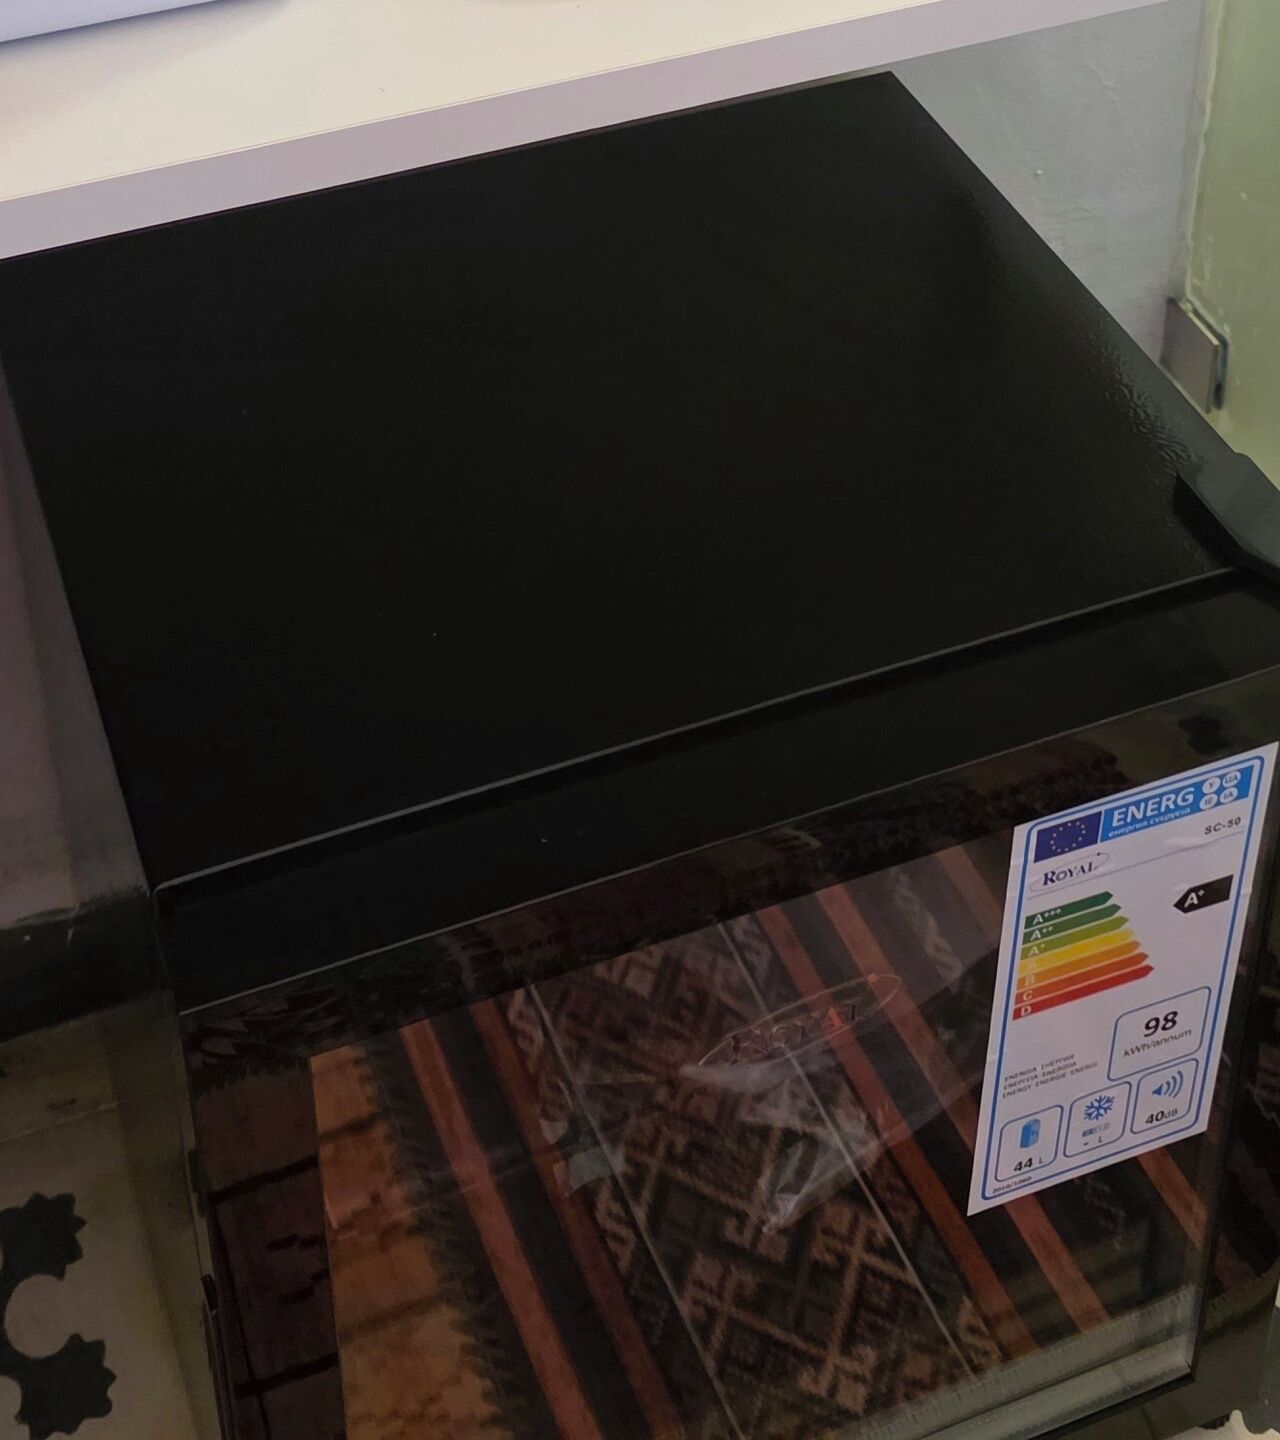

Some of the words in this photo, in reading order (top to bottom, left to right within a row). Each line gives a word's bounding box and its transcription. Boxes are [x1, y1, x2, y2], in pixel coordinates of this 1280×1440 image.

[1112, 787, 1195, 828] ENERG
[1204, 816, 1242, 836] SC-50
[1042, 862, 1094, 887] ROYAL
[1184, 889, 1206, 909] A+
[1022, 990, 1033, 1001] C
[1020, 1005, 1032, 1016] D
[1144, 1011, 1178, 1038] 98
[1123, 1029, 1192, 1058] kWh/annum
[1014, 1157, 1033, 1172] 44
